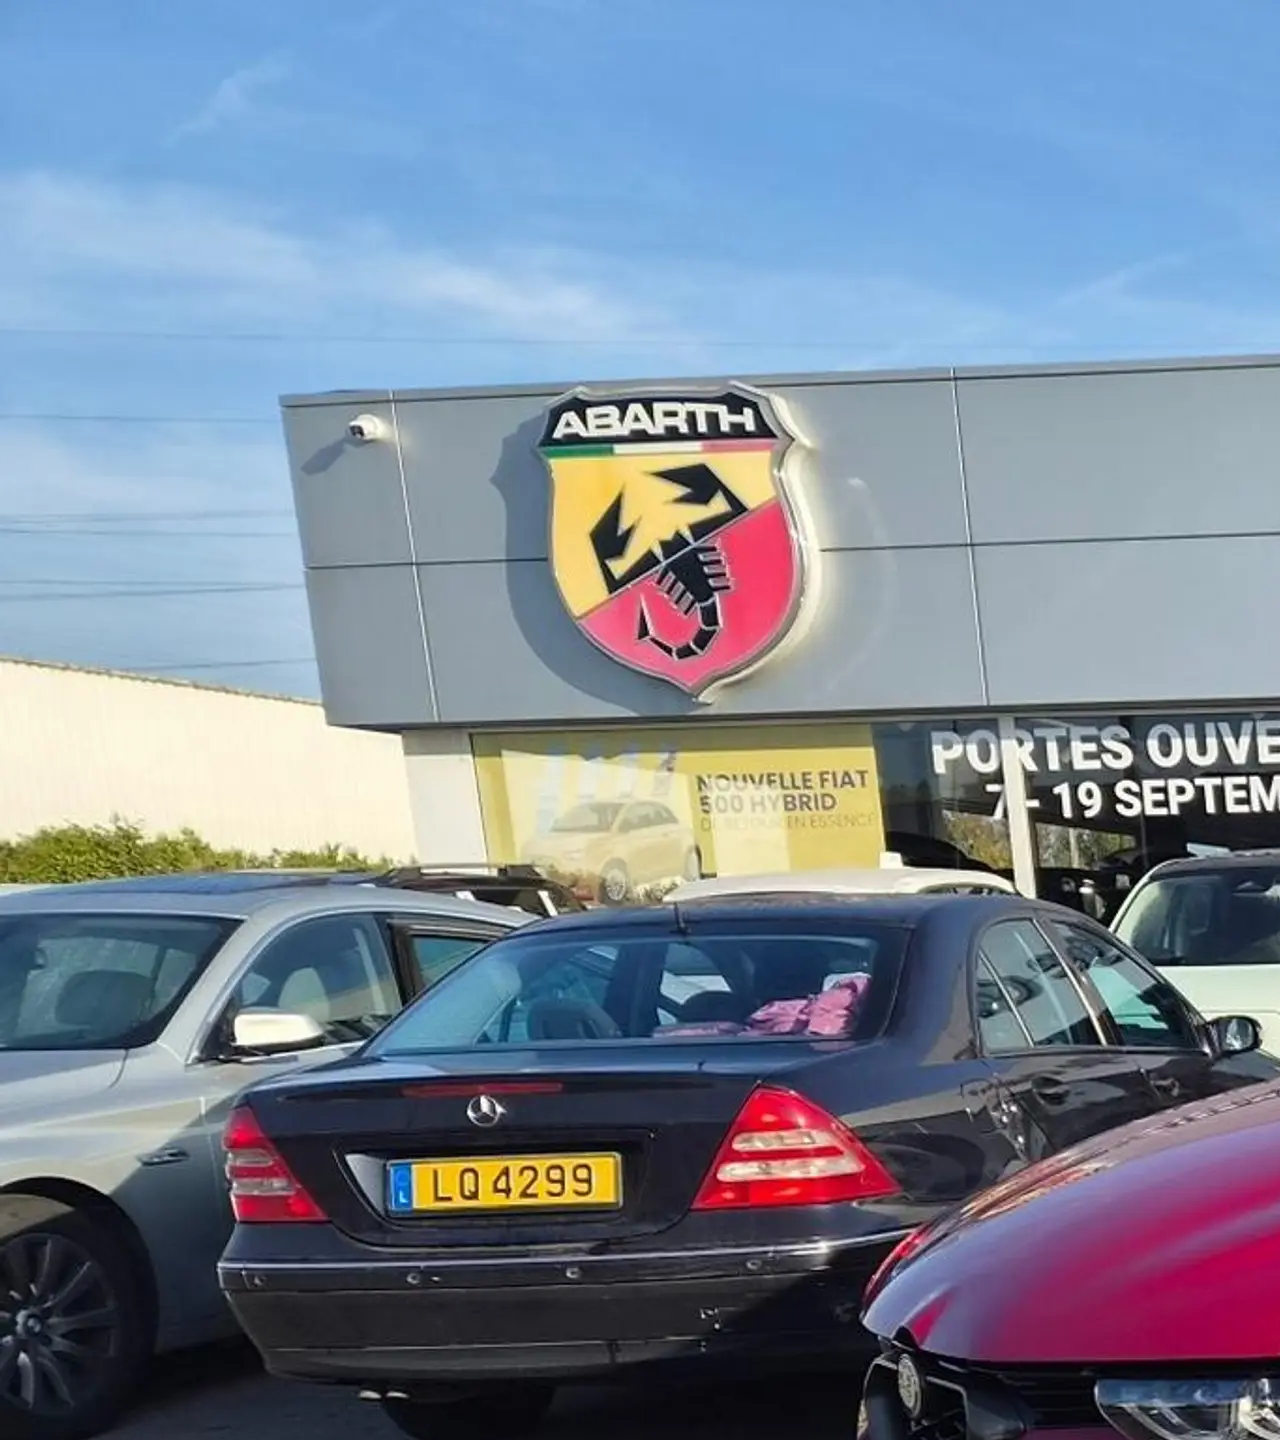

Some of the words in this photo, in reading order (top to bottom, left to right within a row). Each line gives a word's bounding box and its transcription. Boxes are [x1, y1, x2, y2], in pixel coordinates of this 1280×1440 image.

[552, 401, 755, 439] ABARTH
[930, 725, 1134, 774] PORTES
[696, 771, 814, 792] NOUVELLE
[819, 770, 869, 788] FIAT
[1052, 780, 1102, 818] 19
[700, 795, 743, 814] 500
[751, 793, 837, 812] HYBRID
[433, 1168, 479, 1202] LQ
[492, 1163, 593, 1199] 4299
